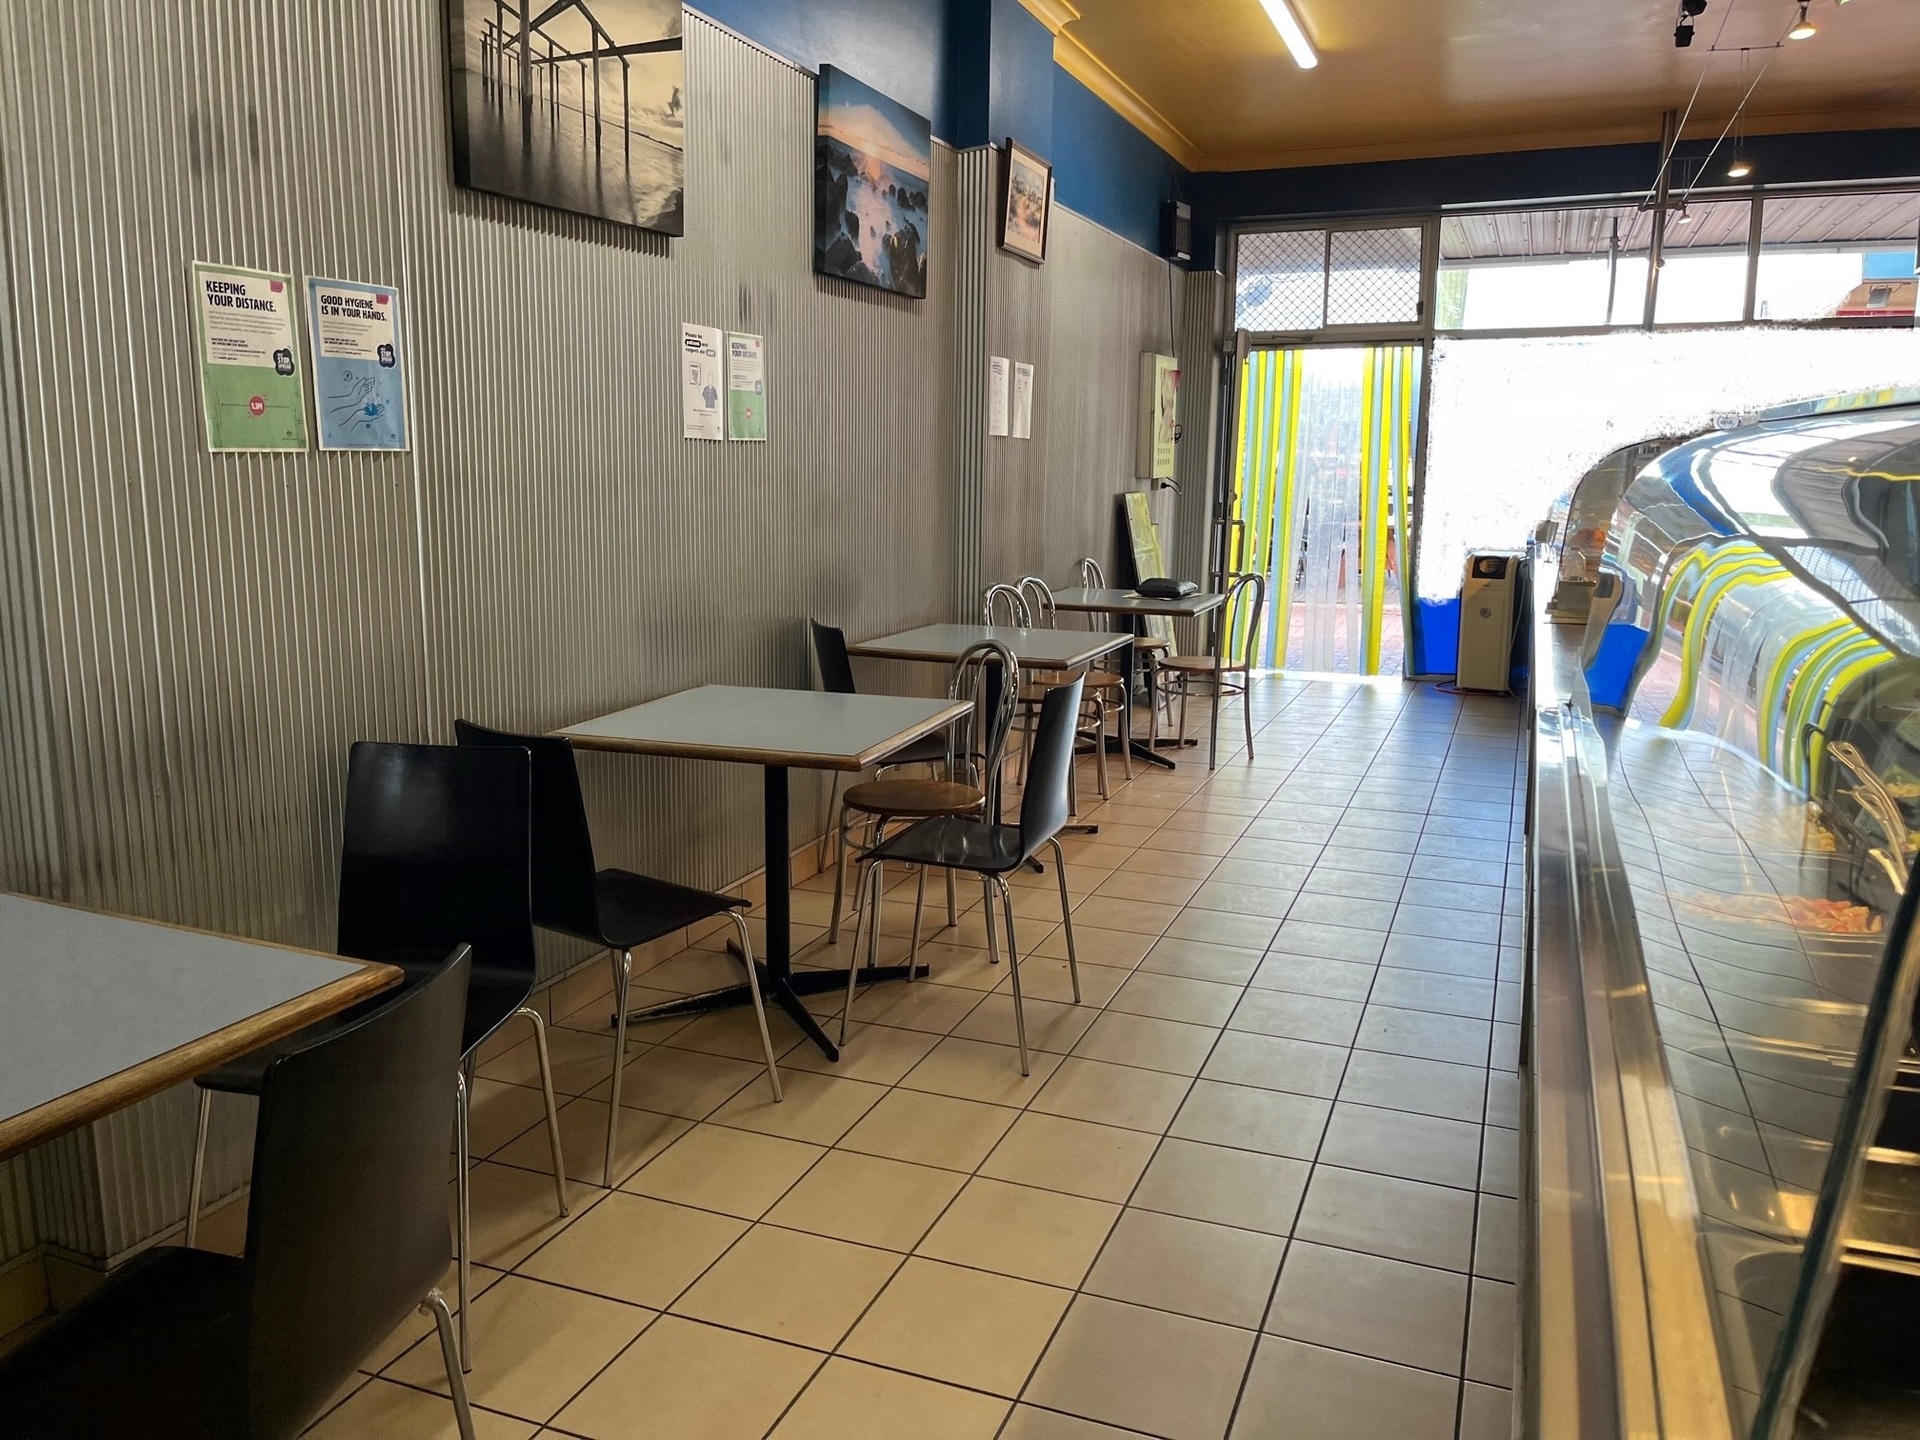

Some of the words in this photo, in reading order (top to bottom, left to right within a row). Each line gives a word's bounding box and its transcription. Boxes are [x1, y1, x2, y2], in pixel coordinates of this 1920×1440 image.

[206, 280, 246, 296] KEEPING
[207, 293, 234, 308] YOUR
[235, 296, 277, 313] DISTANCE.
[321, 294, 343, 306] GOOD
[344, 297, 374, 310] HYGIENE
[321, 305, 329, 315] IS
[330, 306, 340, 316] IN
[341, 307, 362, 318] YOUR
[362, 309, 388, 321] HANDS.
